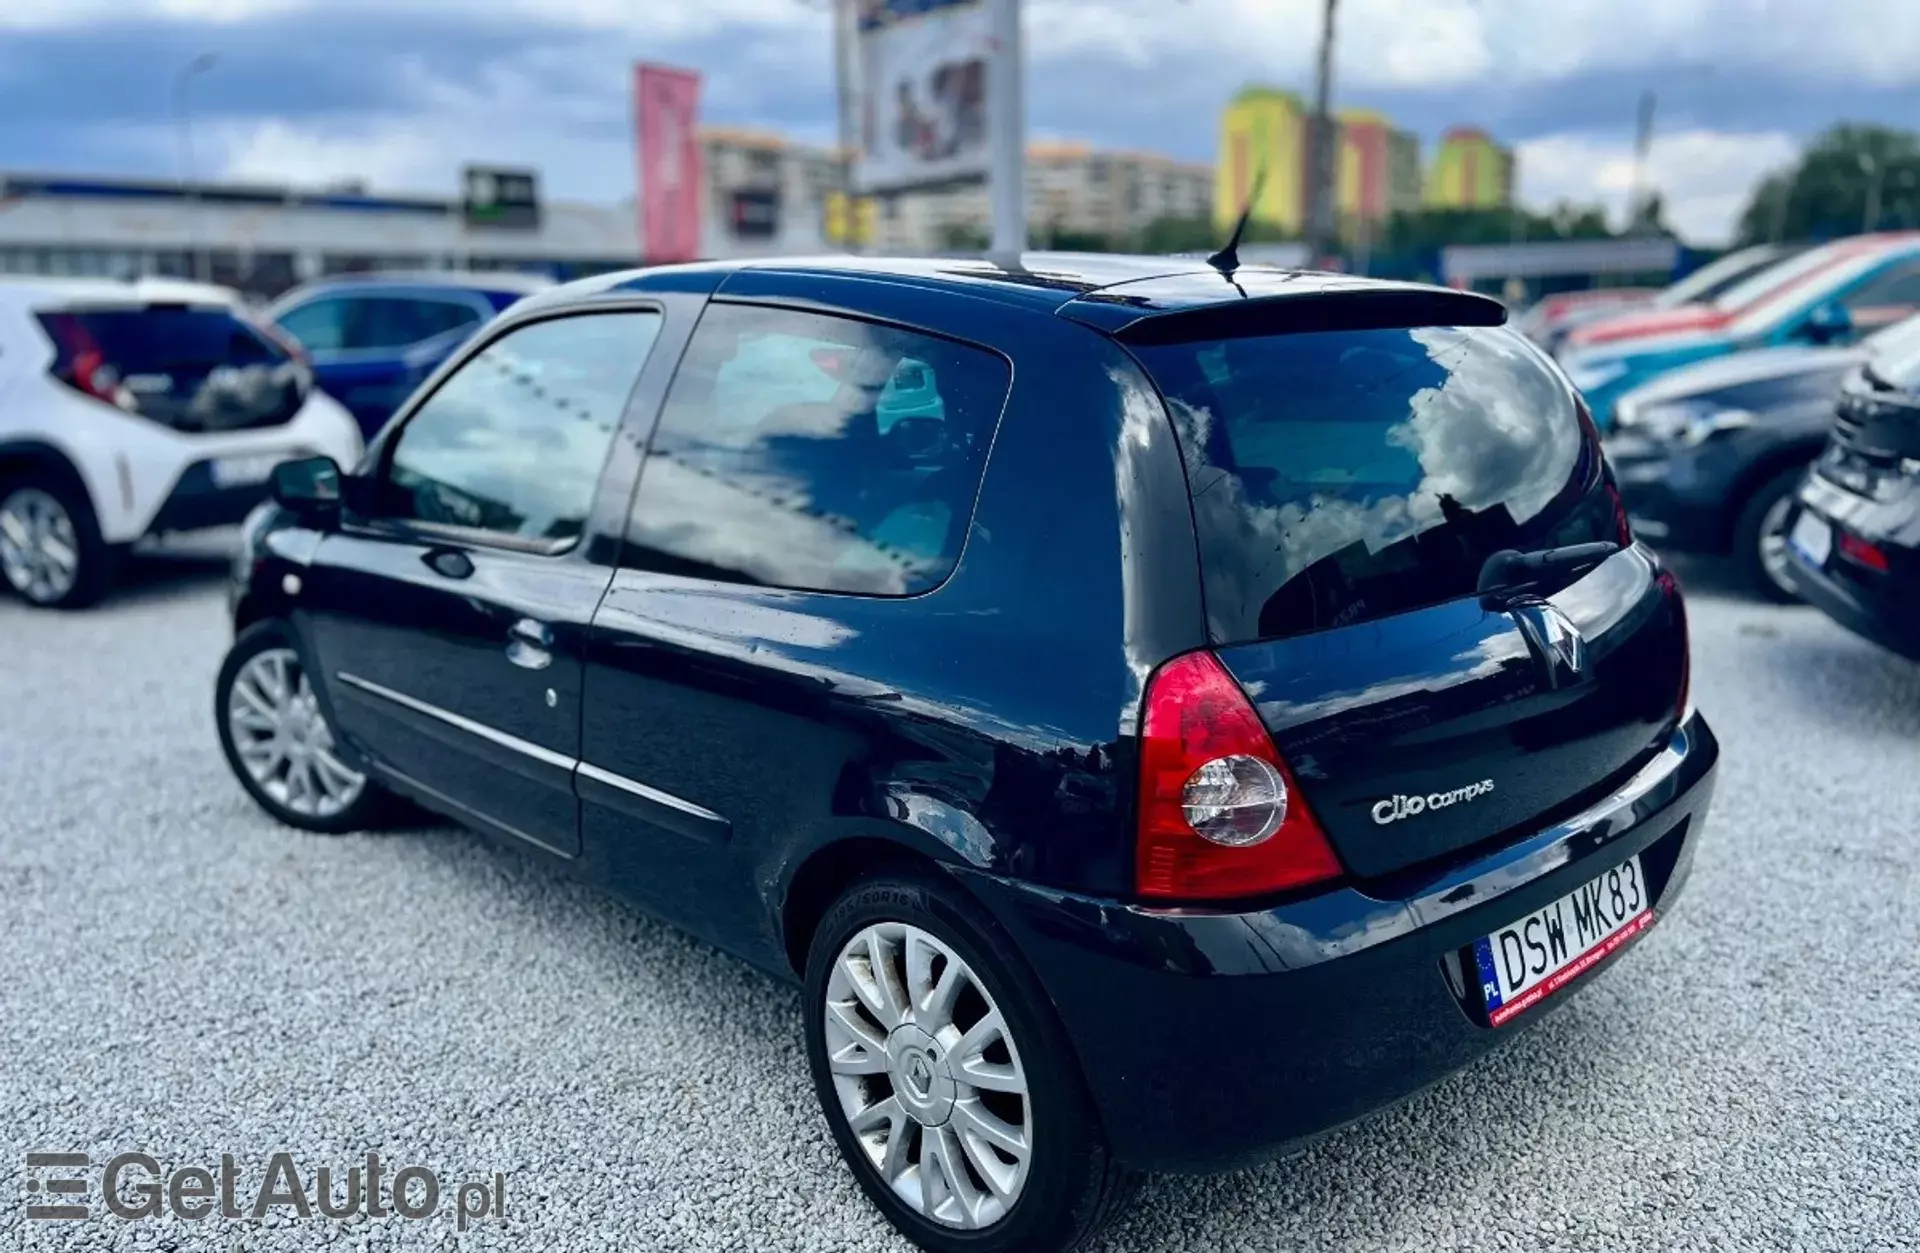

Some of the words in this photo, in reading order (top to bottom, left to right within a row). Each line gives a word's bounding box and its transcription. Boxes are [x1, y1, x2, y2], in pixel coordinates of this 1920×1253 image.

[1371, 794, 1425, 825] Clio
[1500, 902, 1568, 993] DSW
[1572, 861, 1640, 947] MK83
[1483, 983, 1499, 1001] PL
